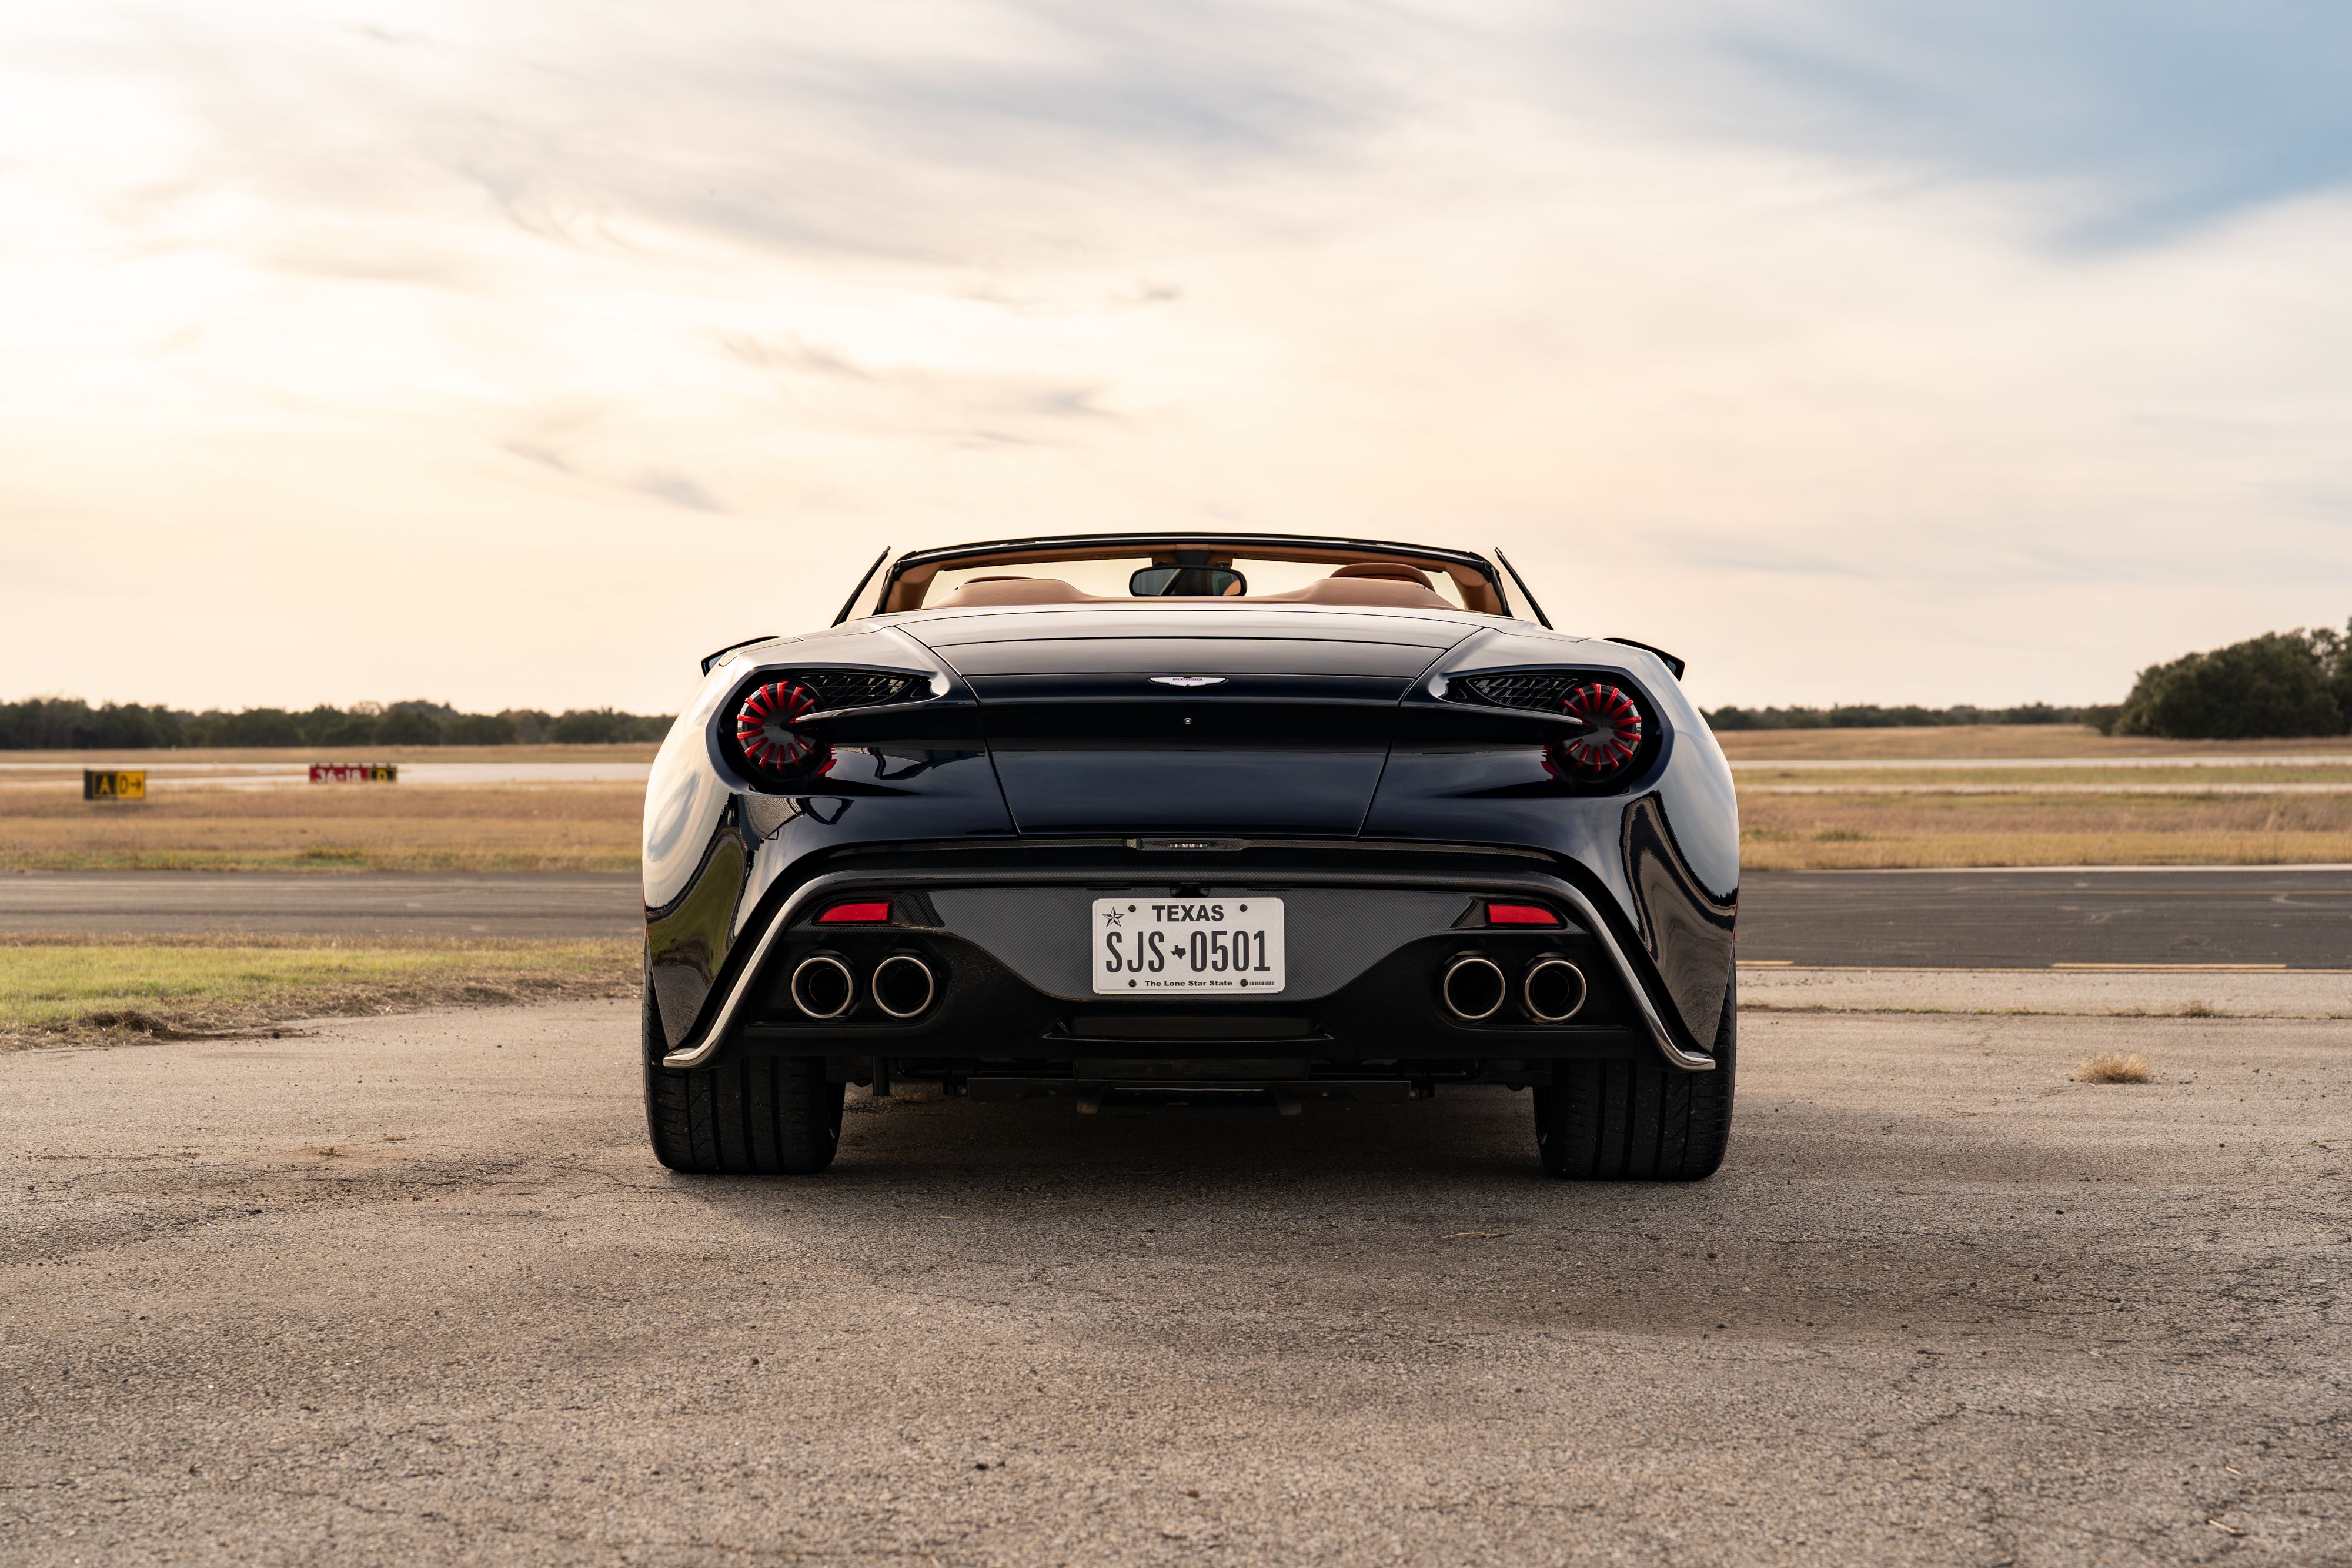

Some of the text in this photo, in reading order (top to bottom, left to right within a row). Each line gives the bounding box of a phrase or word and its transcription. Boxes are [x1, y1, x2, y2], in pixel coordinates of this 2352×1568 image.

[99, 775, 128, 794] A D
[1152, 904, 1224, 922] TEXAS
[1105, 930, 1271, 972] SJS 0501
